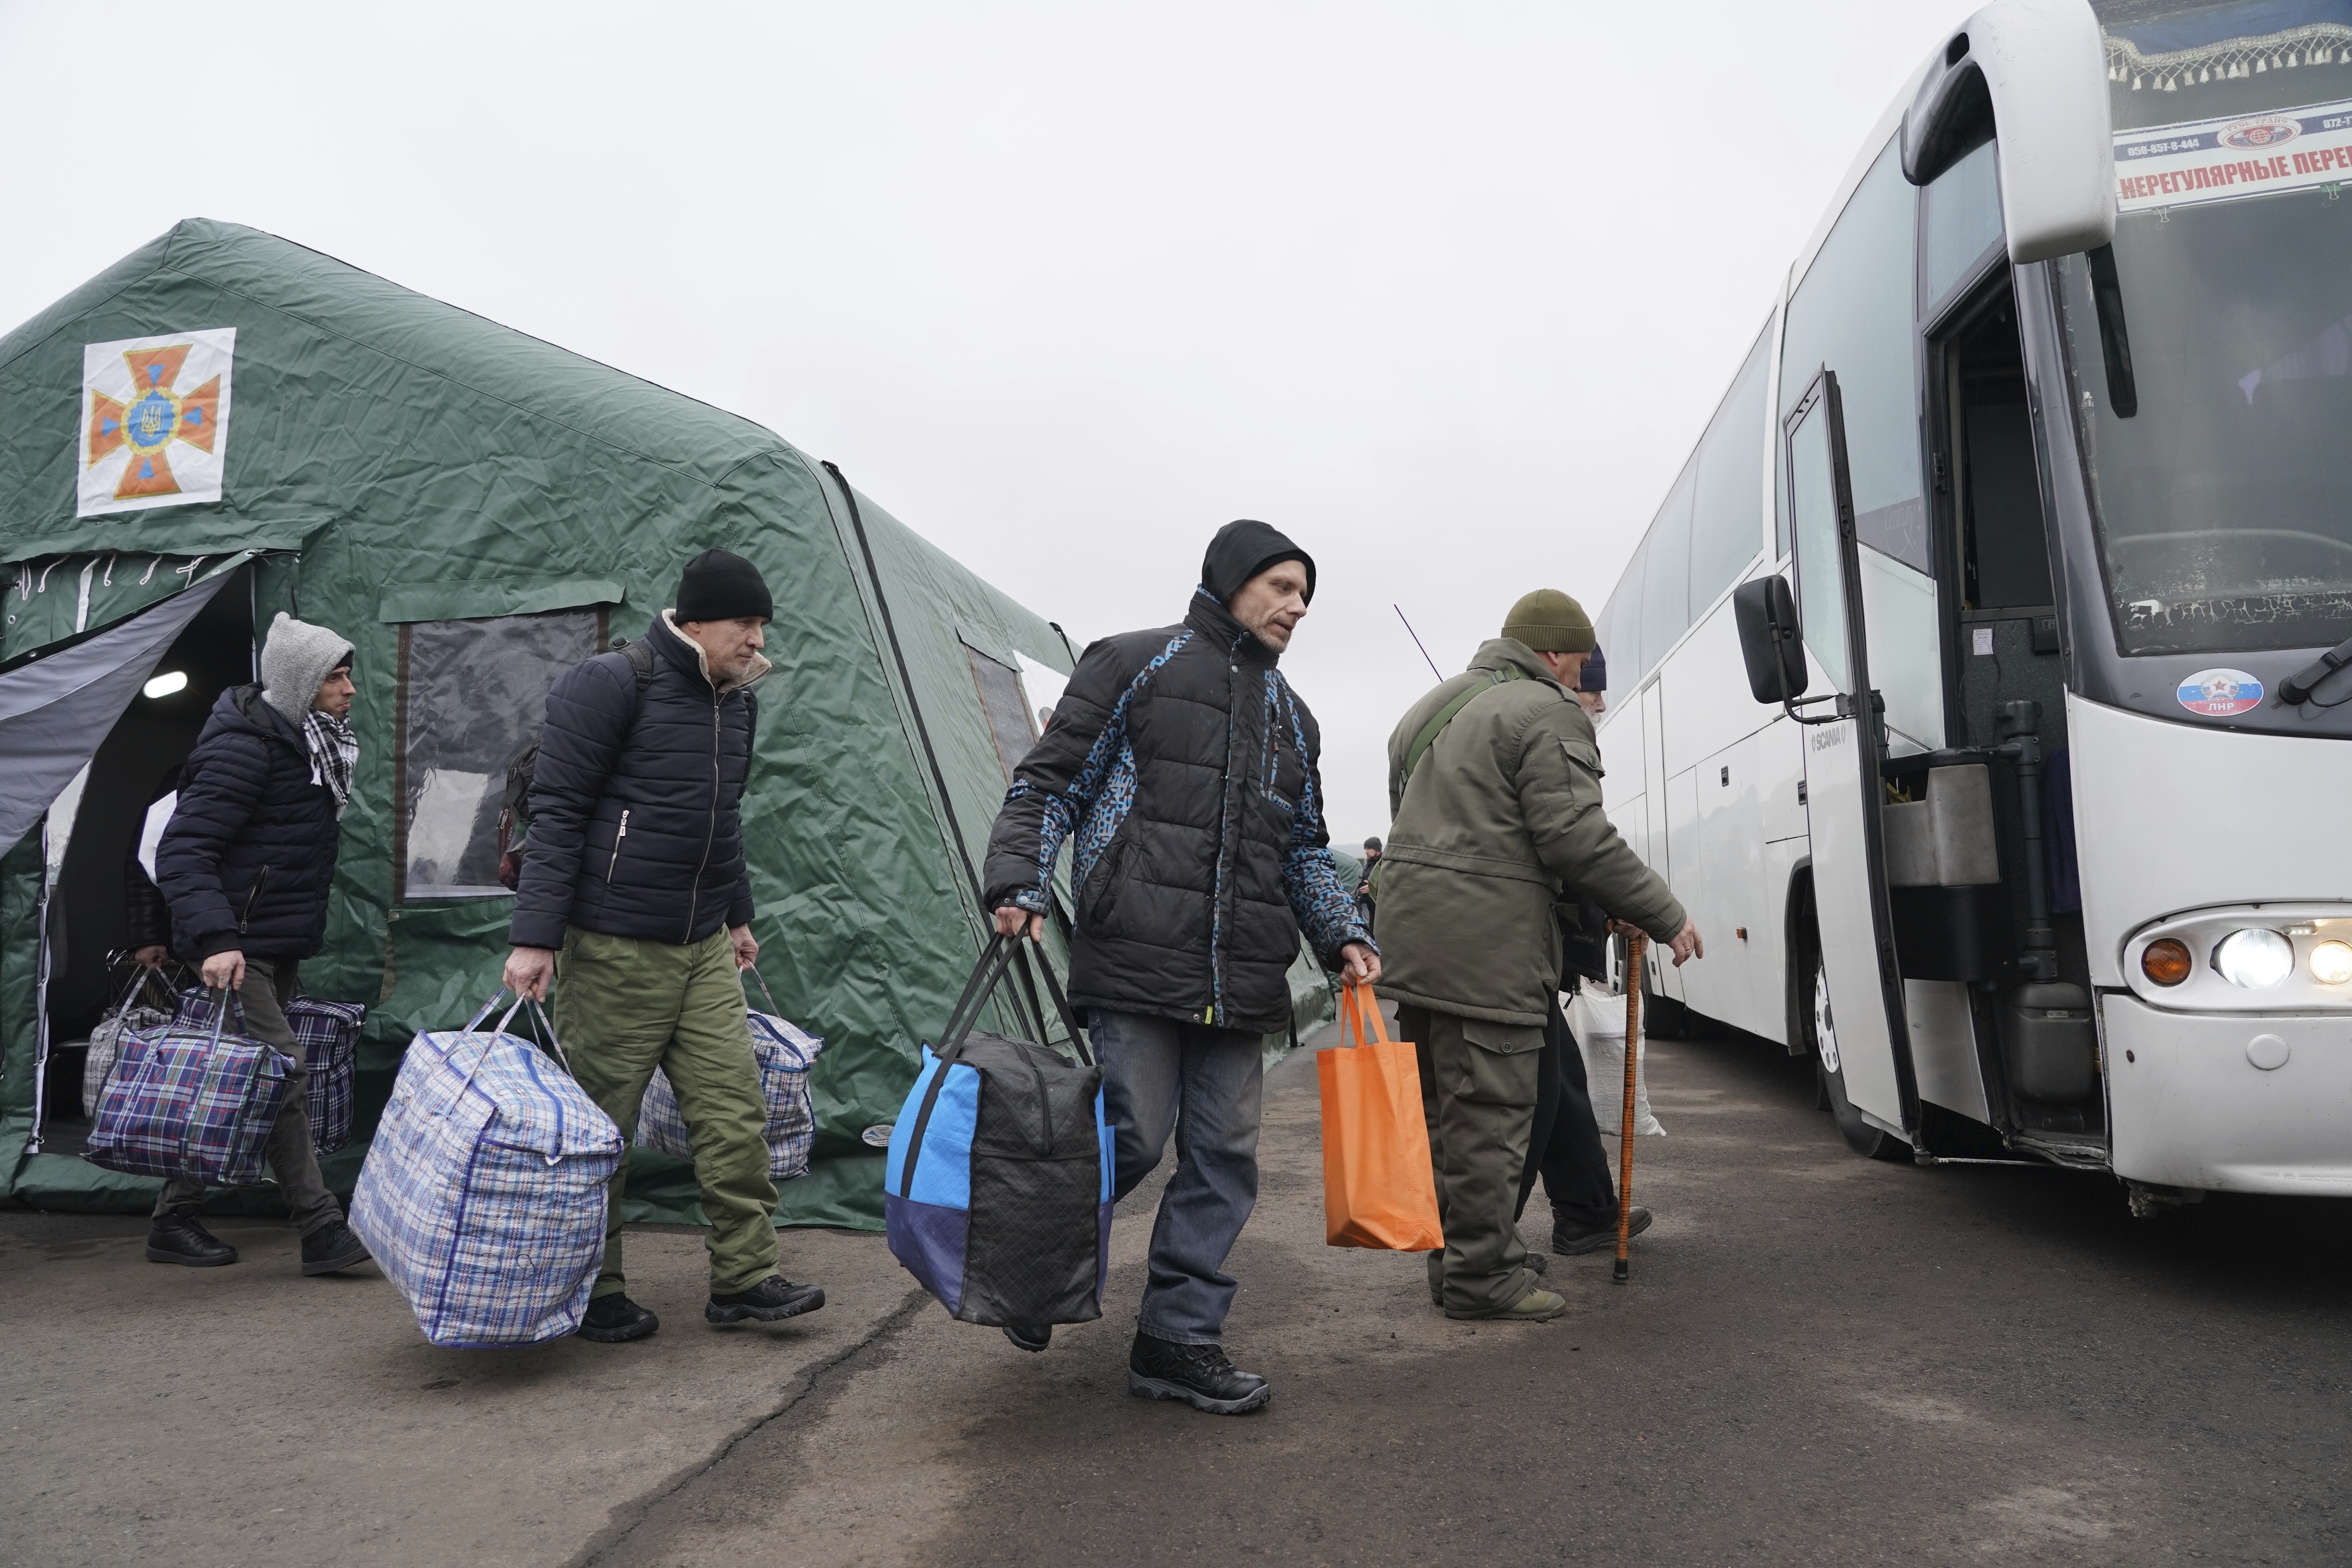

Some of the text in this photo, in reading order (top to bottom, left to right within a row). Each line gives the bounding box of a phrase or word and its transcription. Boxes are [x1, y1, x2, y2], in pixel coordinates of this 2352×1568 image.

[2127, 138, 2200, 157] 050-857-8-444
[2120, 156, 2291, 200] НЕРЕГУЛЯРНЫЕ
[1816, 726, 1841, 751] SCANIA
